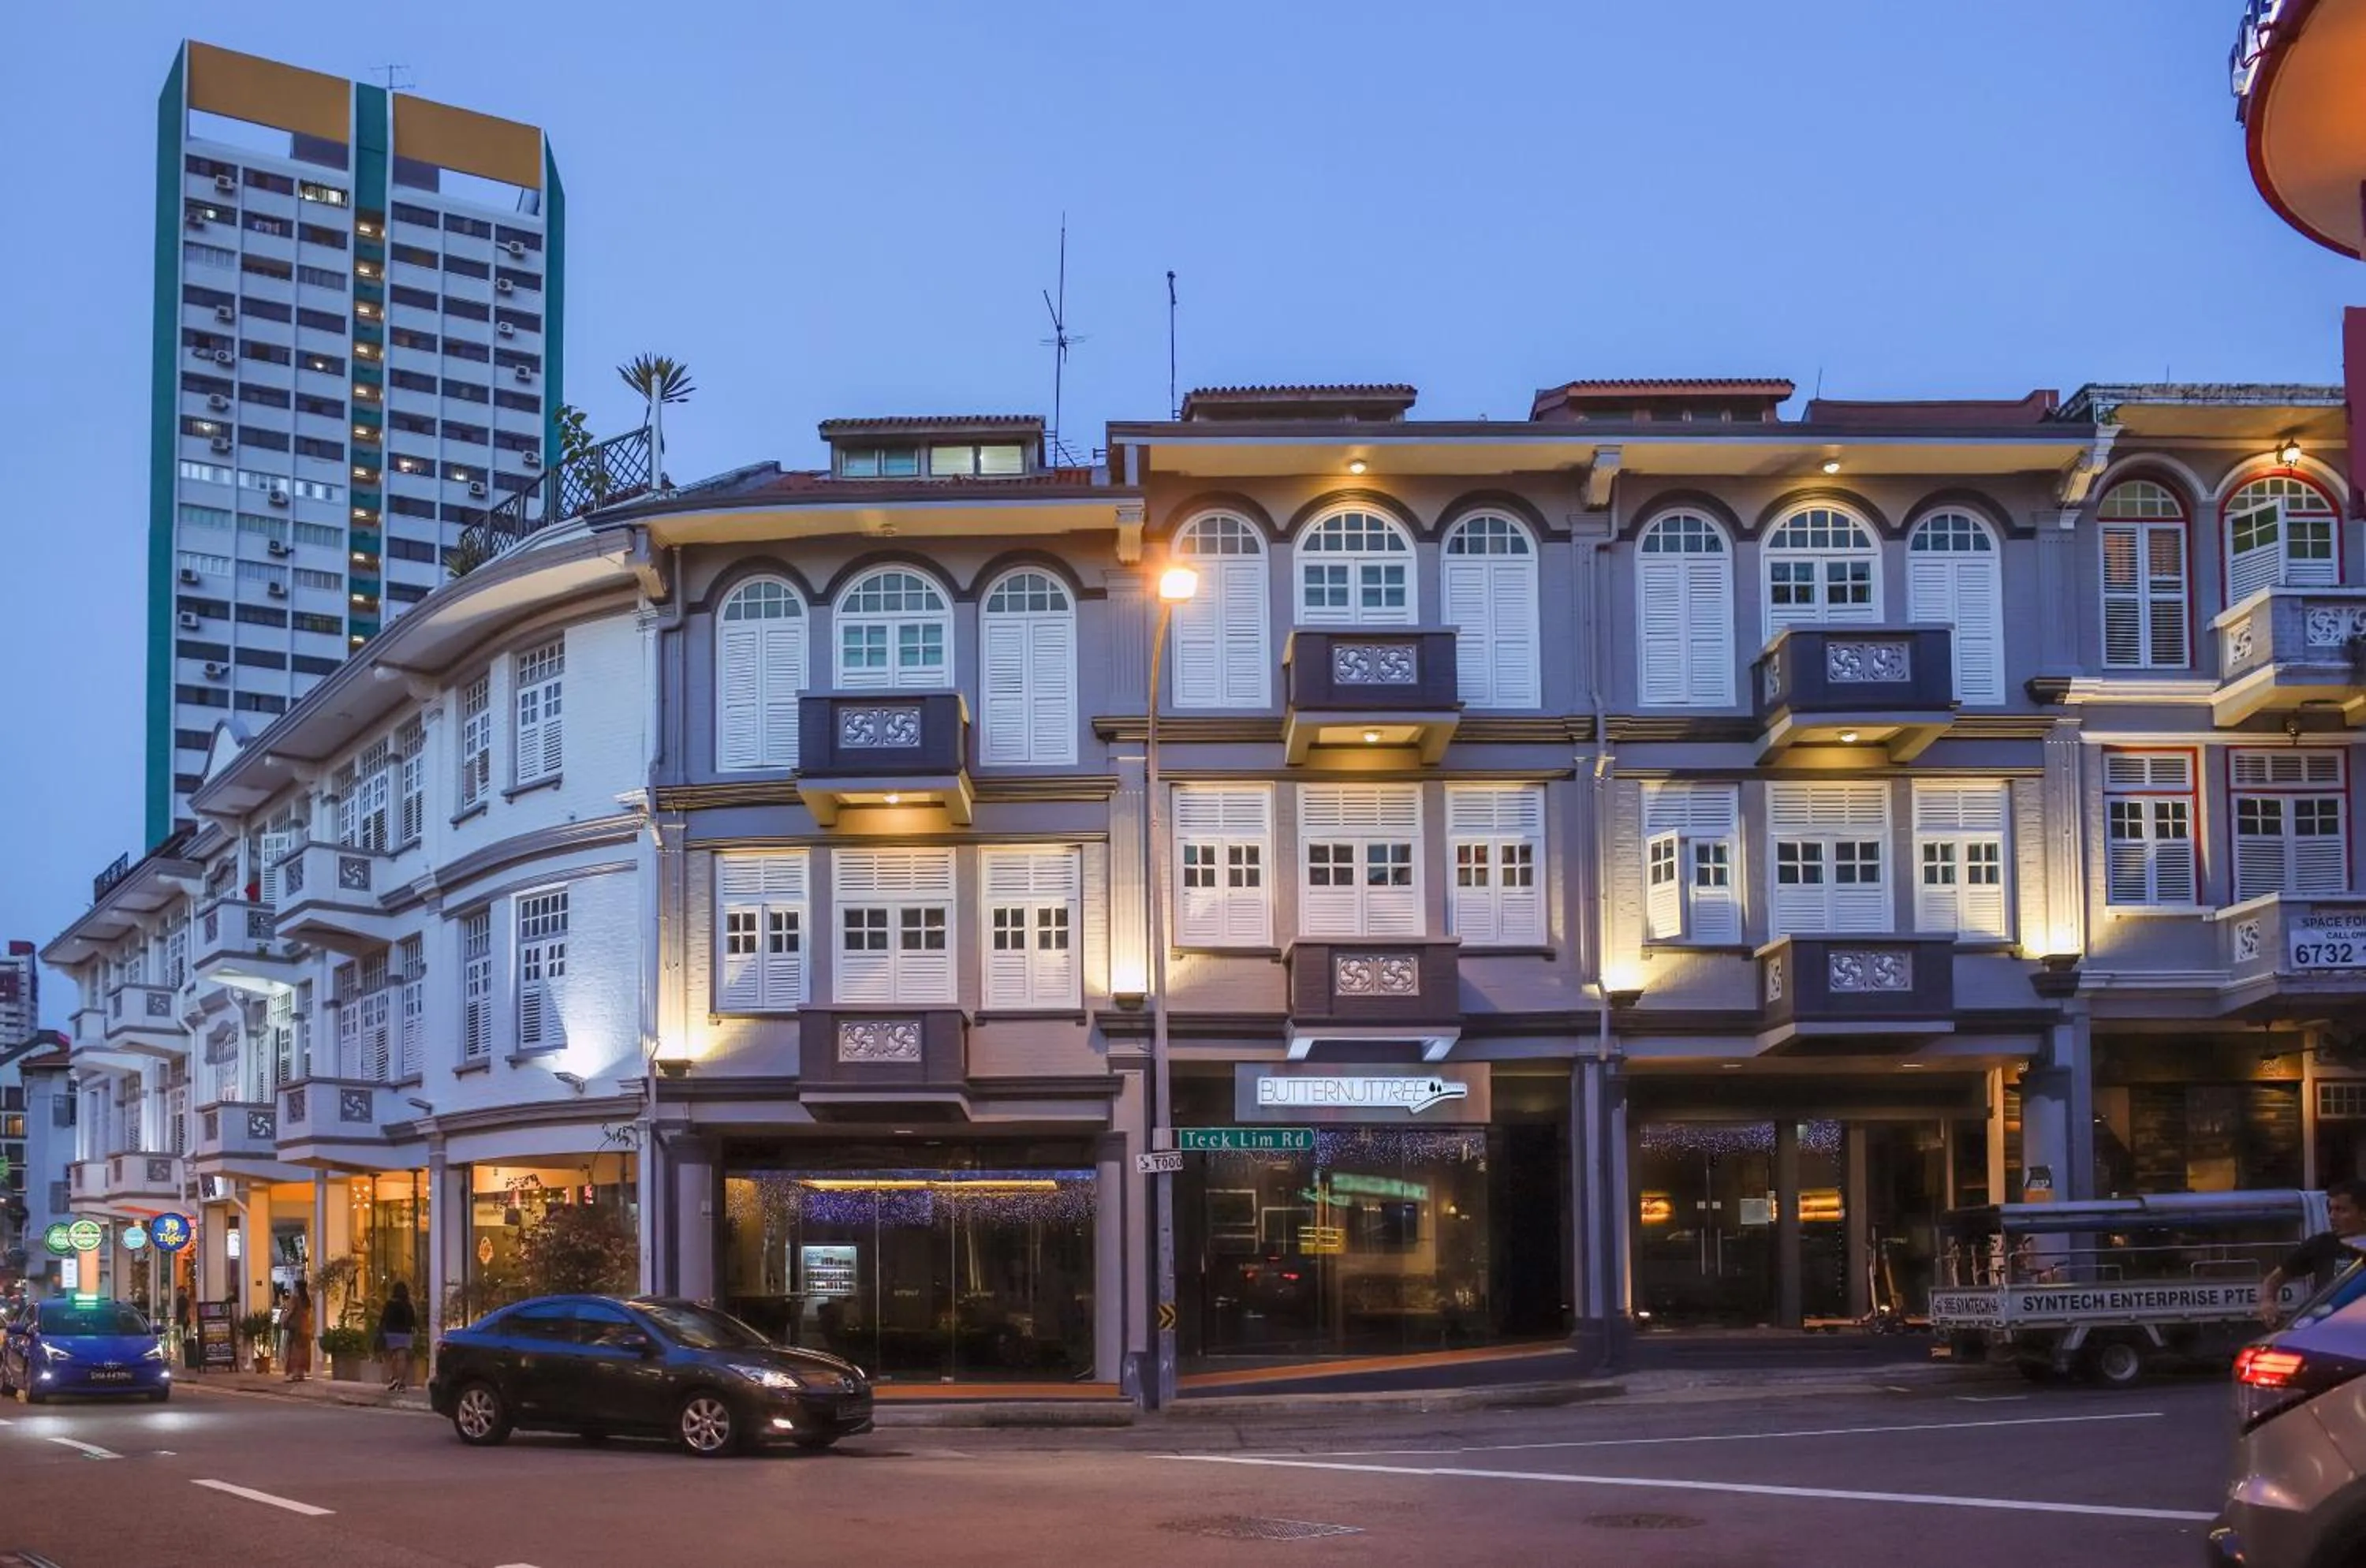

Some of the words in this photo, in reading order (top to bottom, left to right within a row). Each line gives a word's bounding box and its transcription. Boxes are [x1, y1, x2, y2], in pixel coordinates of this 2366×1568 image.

[2345, 915, 2366, 927] FO
[2296, 943, 2353, 964] 6732
[1186, 1132, 1230, 1148] Teck
[1240, 1132, 1273, 1148] Lim
[1282, 1132, 1304, 1147] Rd
[158, 1233, 187, 1245] Tiger
[2022, 1294, 2104, 1312] SYNTECH
[2110, 1289, 2219, 1309] ENTERPRISE
[2223, 1287, 2256, 1305] PTE
